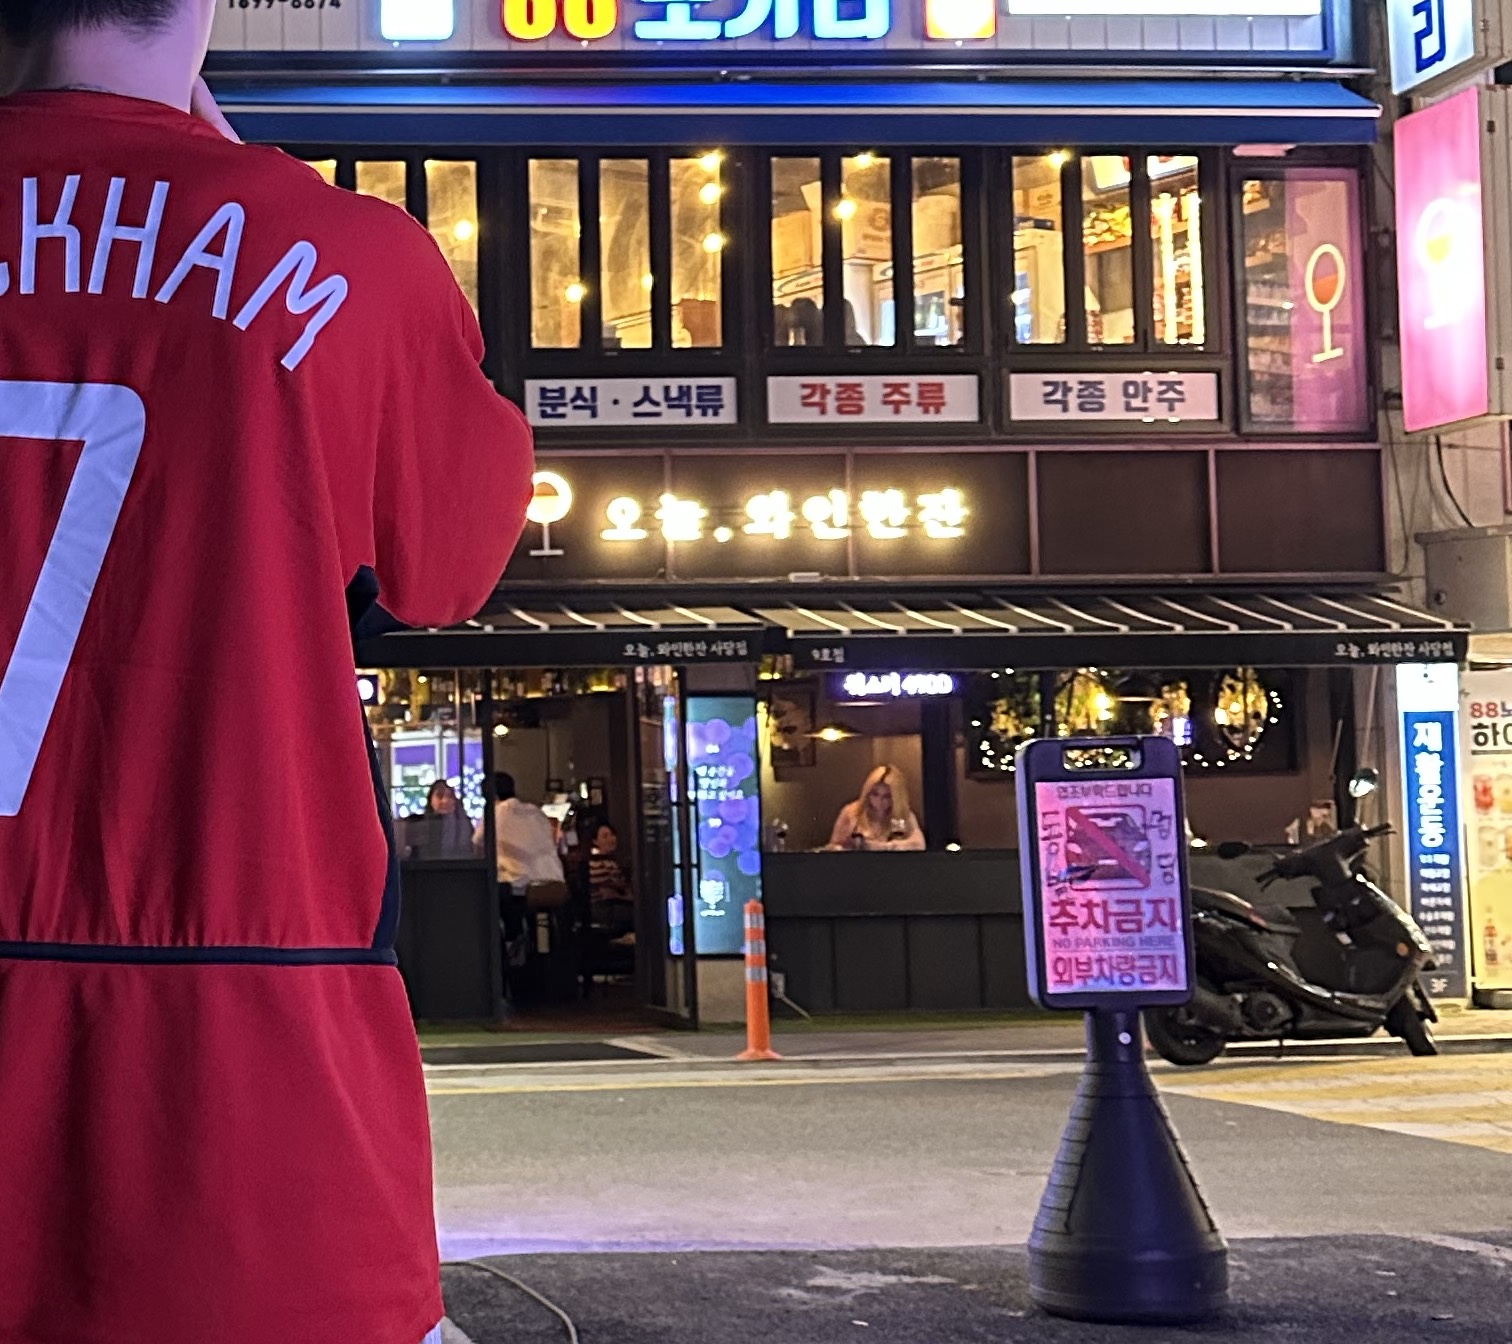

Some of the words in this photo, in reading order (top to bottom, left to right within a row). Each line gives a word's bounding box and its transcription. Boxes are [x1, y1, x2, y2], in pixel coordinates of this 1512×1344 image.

[538, 385, 599, 419] 분식
[632, 384, 725, 418] 스낵류
[799, 382, 866, 416] 각종
[881, 382, 948, 414] 주류
[1041, 379, 1109, 414] 각종
[1122, 380, 1187, 413] 안주
[1049, 897, 1178, 936] 주차금지
[1052, 954, 1180, 987] 외부차량금지
